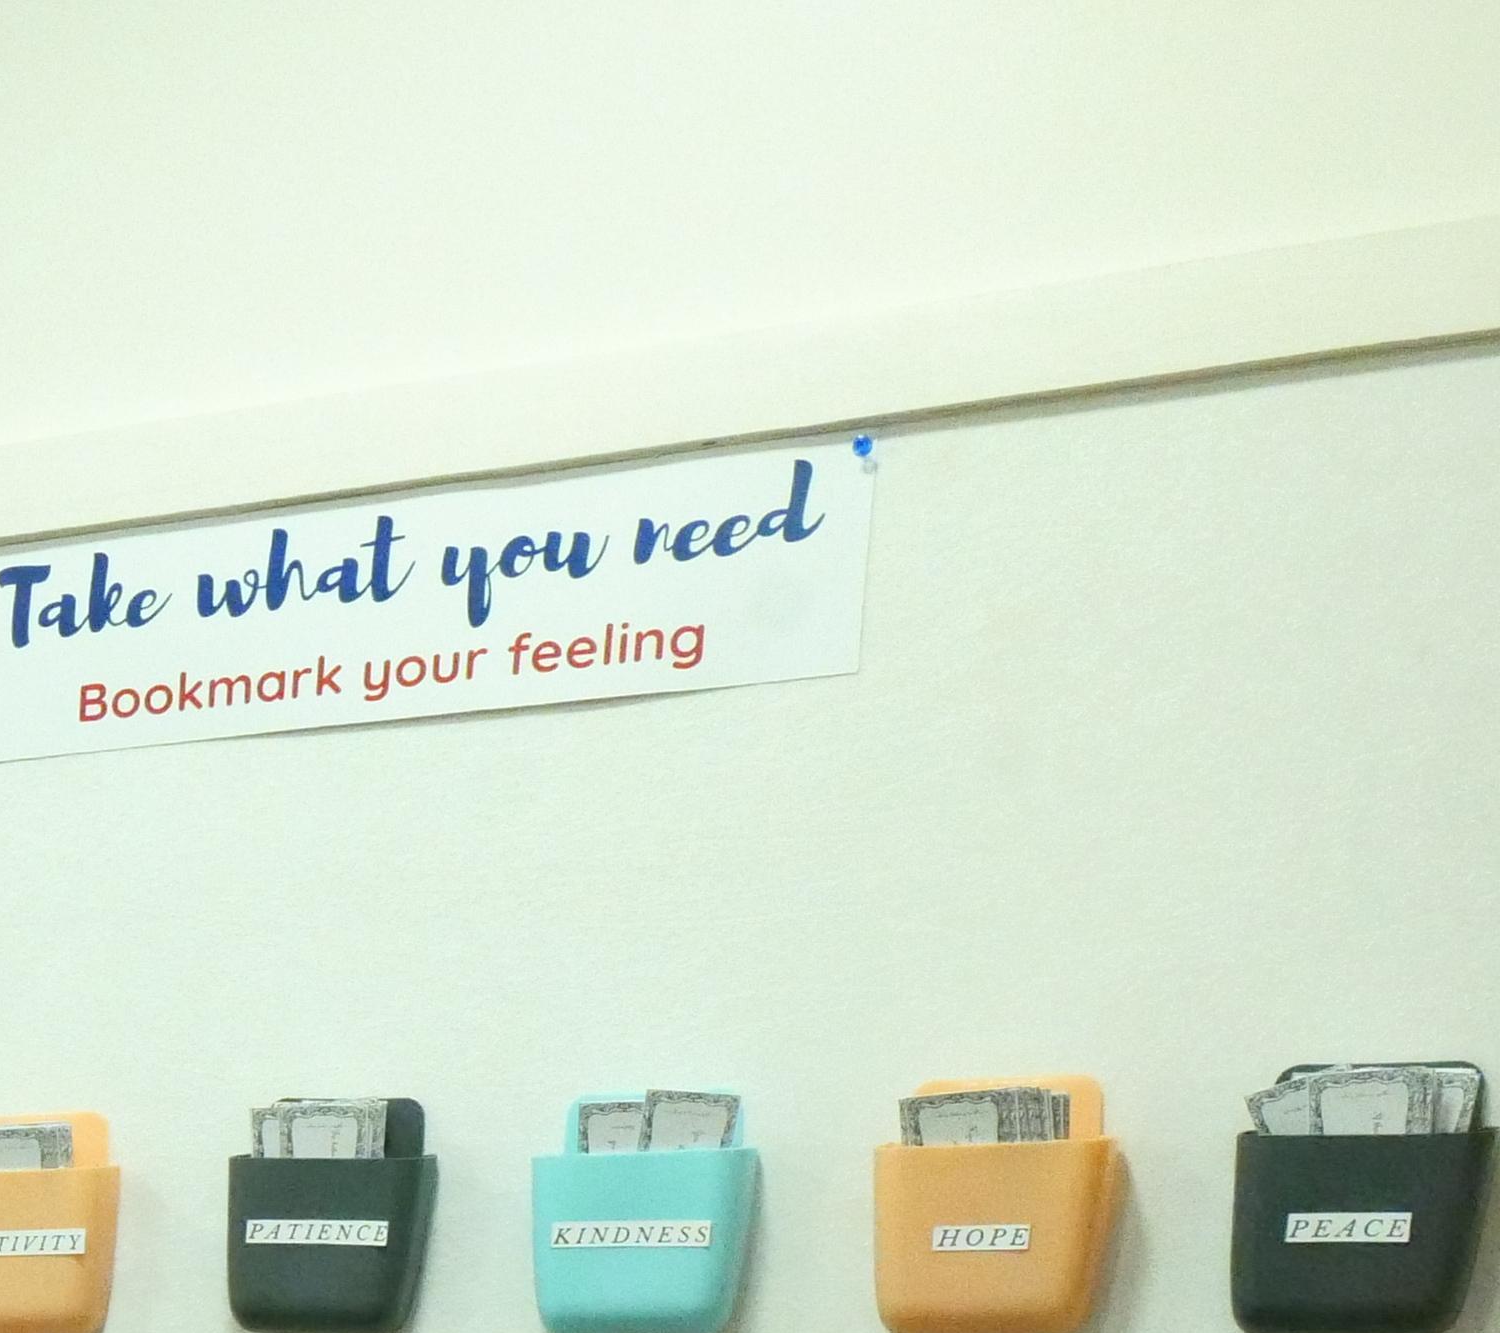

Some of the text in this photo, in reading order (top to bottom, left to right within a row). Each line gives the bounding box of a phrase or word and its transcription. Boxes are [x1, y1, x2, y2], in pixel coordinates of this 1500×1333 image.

[197, 516, 414, 619] what
[441, 523, 609, 628] you
[634, 459, 824, 566] need
[79, 616, 707, 722] Bookmark your feeling
[248, 1221, 389, 1244] PATIENCE
[552, 1225, 711, 1246] KINDNESS
[939, 1226, 1030, 1249] HOPE
[1287, 1216, 1410, 1240] PEACE
